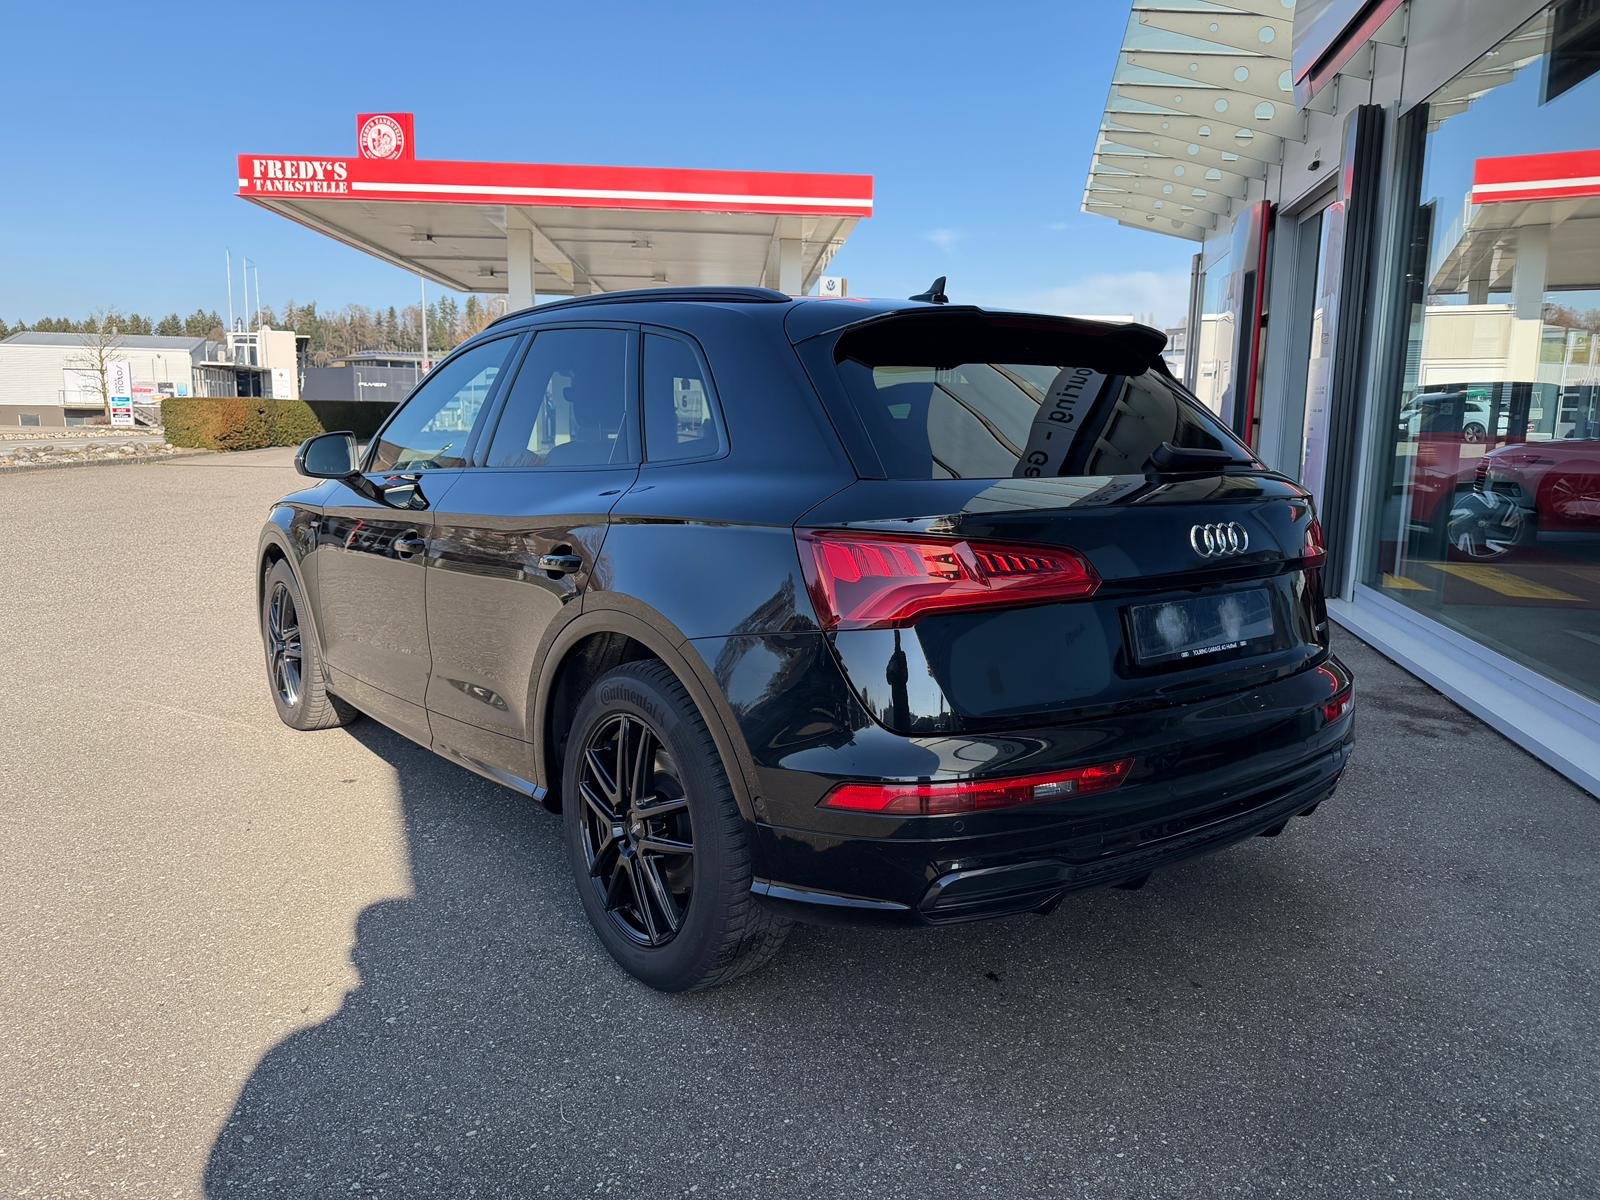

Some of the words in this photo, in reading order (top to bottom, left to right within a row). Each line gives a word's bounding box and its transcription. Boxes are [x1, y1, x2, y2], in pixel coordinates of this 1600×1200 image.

[252, 159, 348, 181] FREDY'S
[253, 179, 348, 194] TANKSTELLE
[600, 683, 659, 719] Continental
